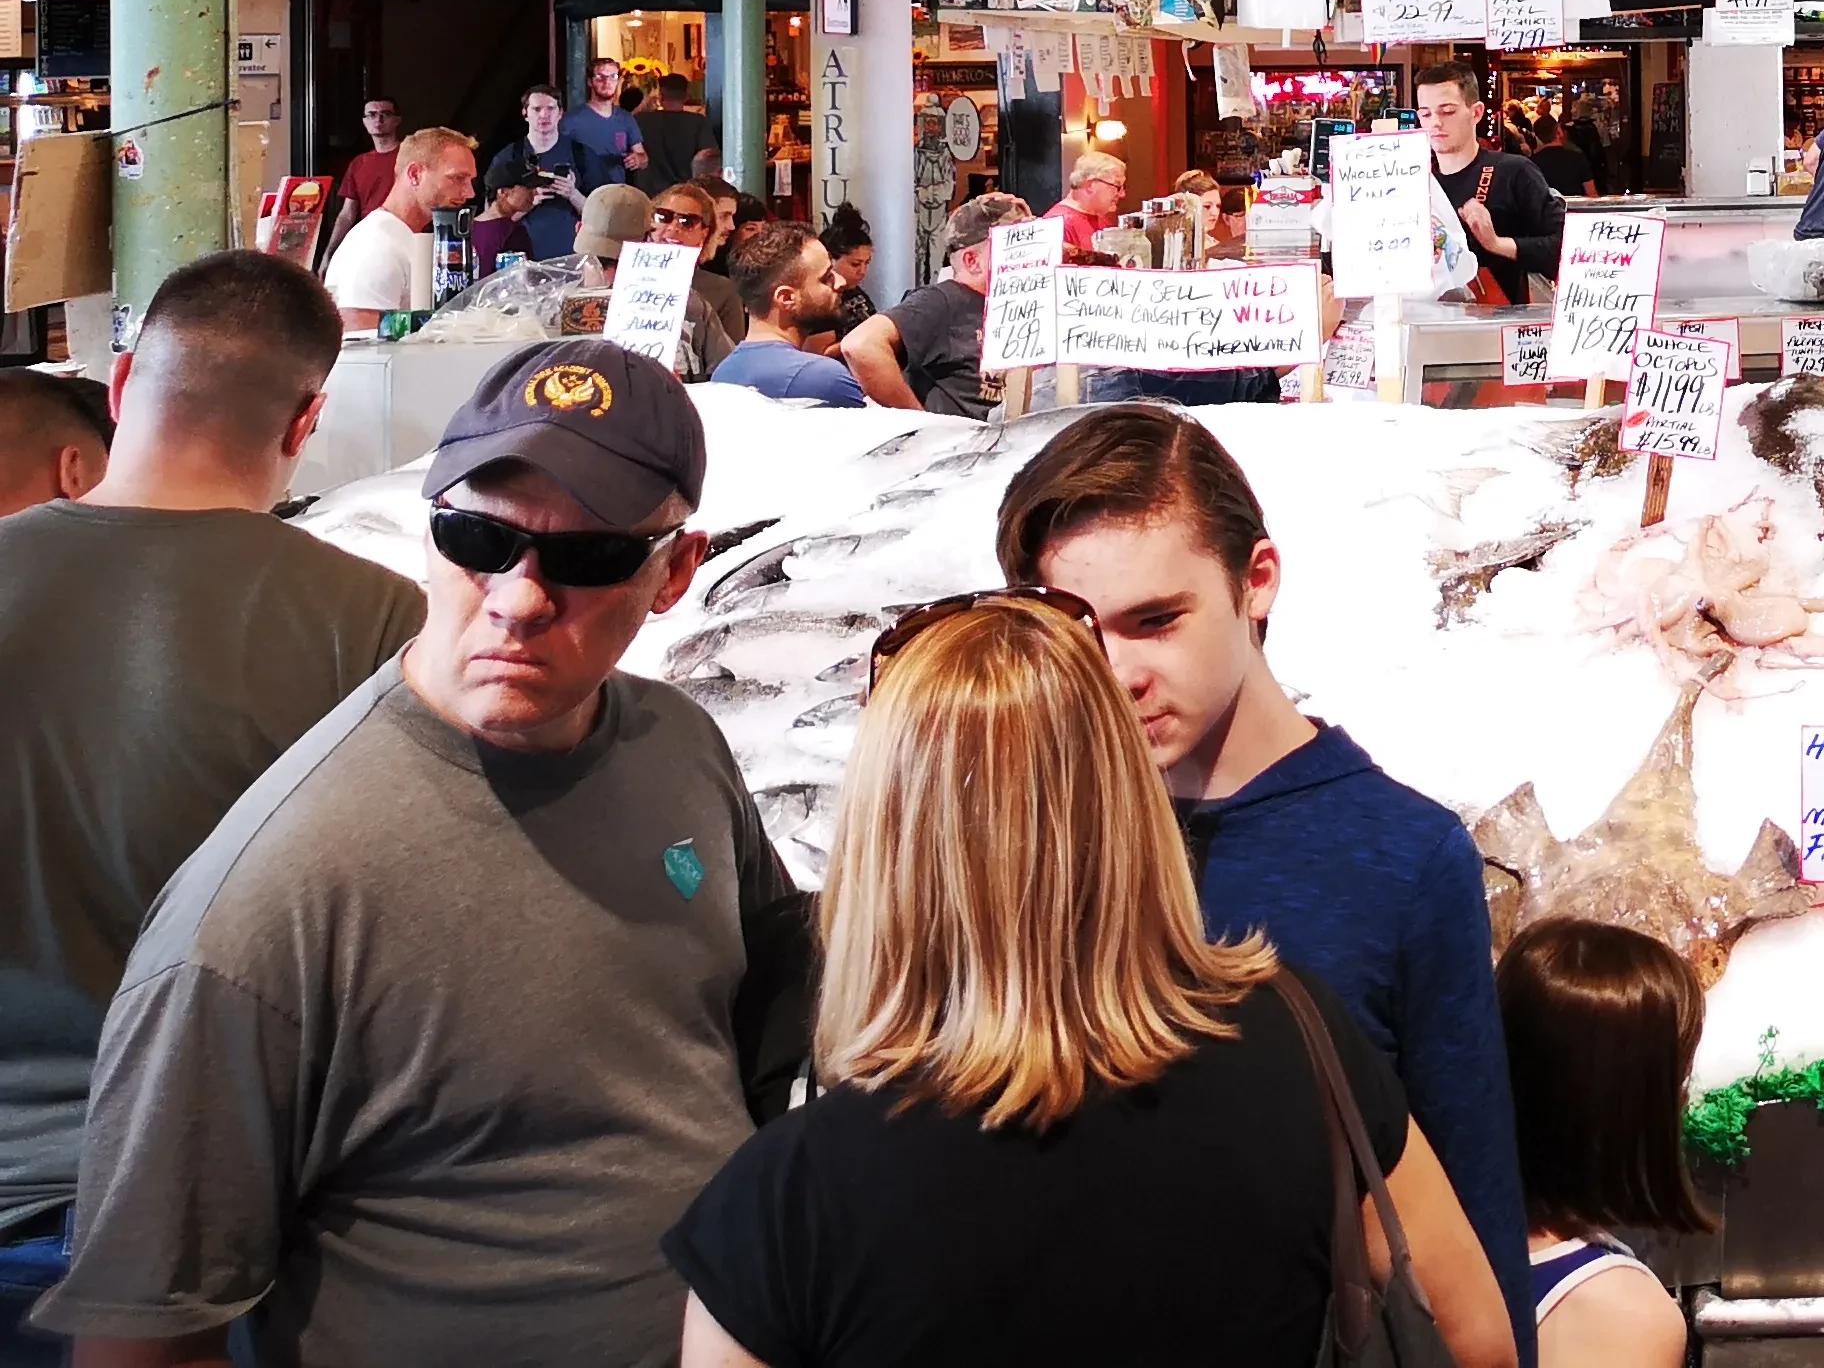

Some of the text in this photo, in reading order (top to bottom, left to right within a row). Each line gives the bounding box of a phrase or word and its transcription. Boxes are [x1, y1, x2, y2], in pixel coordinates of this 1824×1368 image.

[1338, 159, 1422, 182] WHOLE WILD
[1003, 225, 1045, 247] FRESH
[1589, 221, 1650, 245] FRESH
[993, 273, 1054, 298] ALBACORE
[1064, 275, 1289, 304] WE ONLY SELL WILD
[1559, 281, 1655, 313] HALIBUT
[993, 300, 1045, 324] TUNA
[1057, 299, 1295, 336] SALMON CAUGHT BY WILD
[1062, 324, 1149, 355] FISHERMEN
[1156, 337, 1181, 352] AND
[1181, 328, 1304, 360] FISHERWOMEN
[1507, 345, 1548, 363] TUNA
[1646, 333, 1713, 355] WHOLE
[1633, 351, 1719, 378] OCTOPUS
[1628, 371, 1706, 416] $11.99
